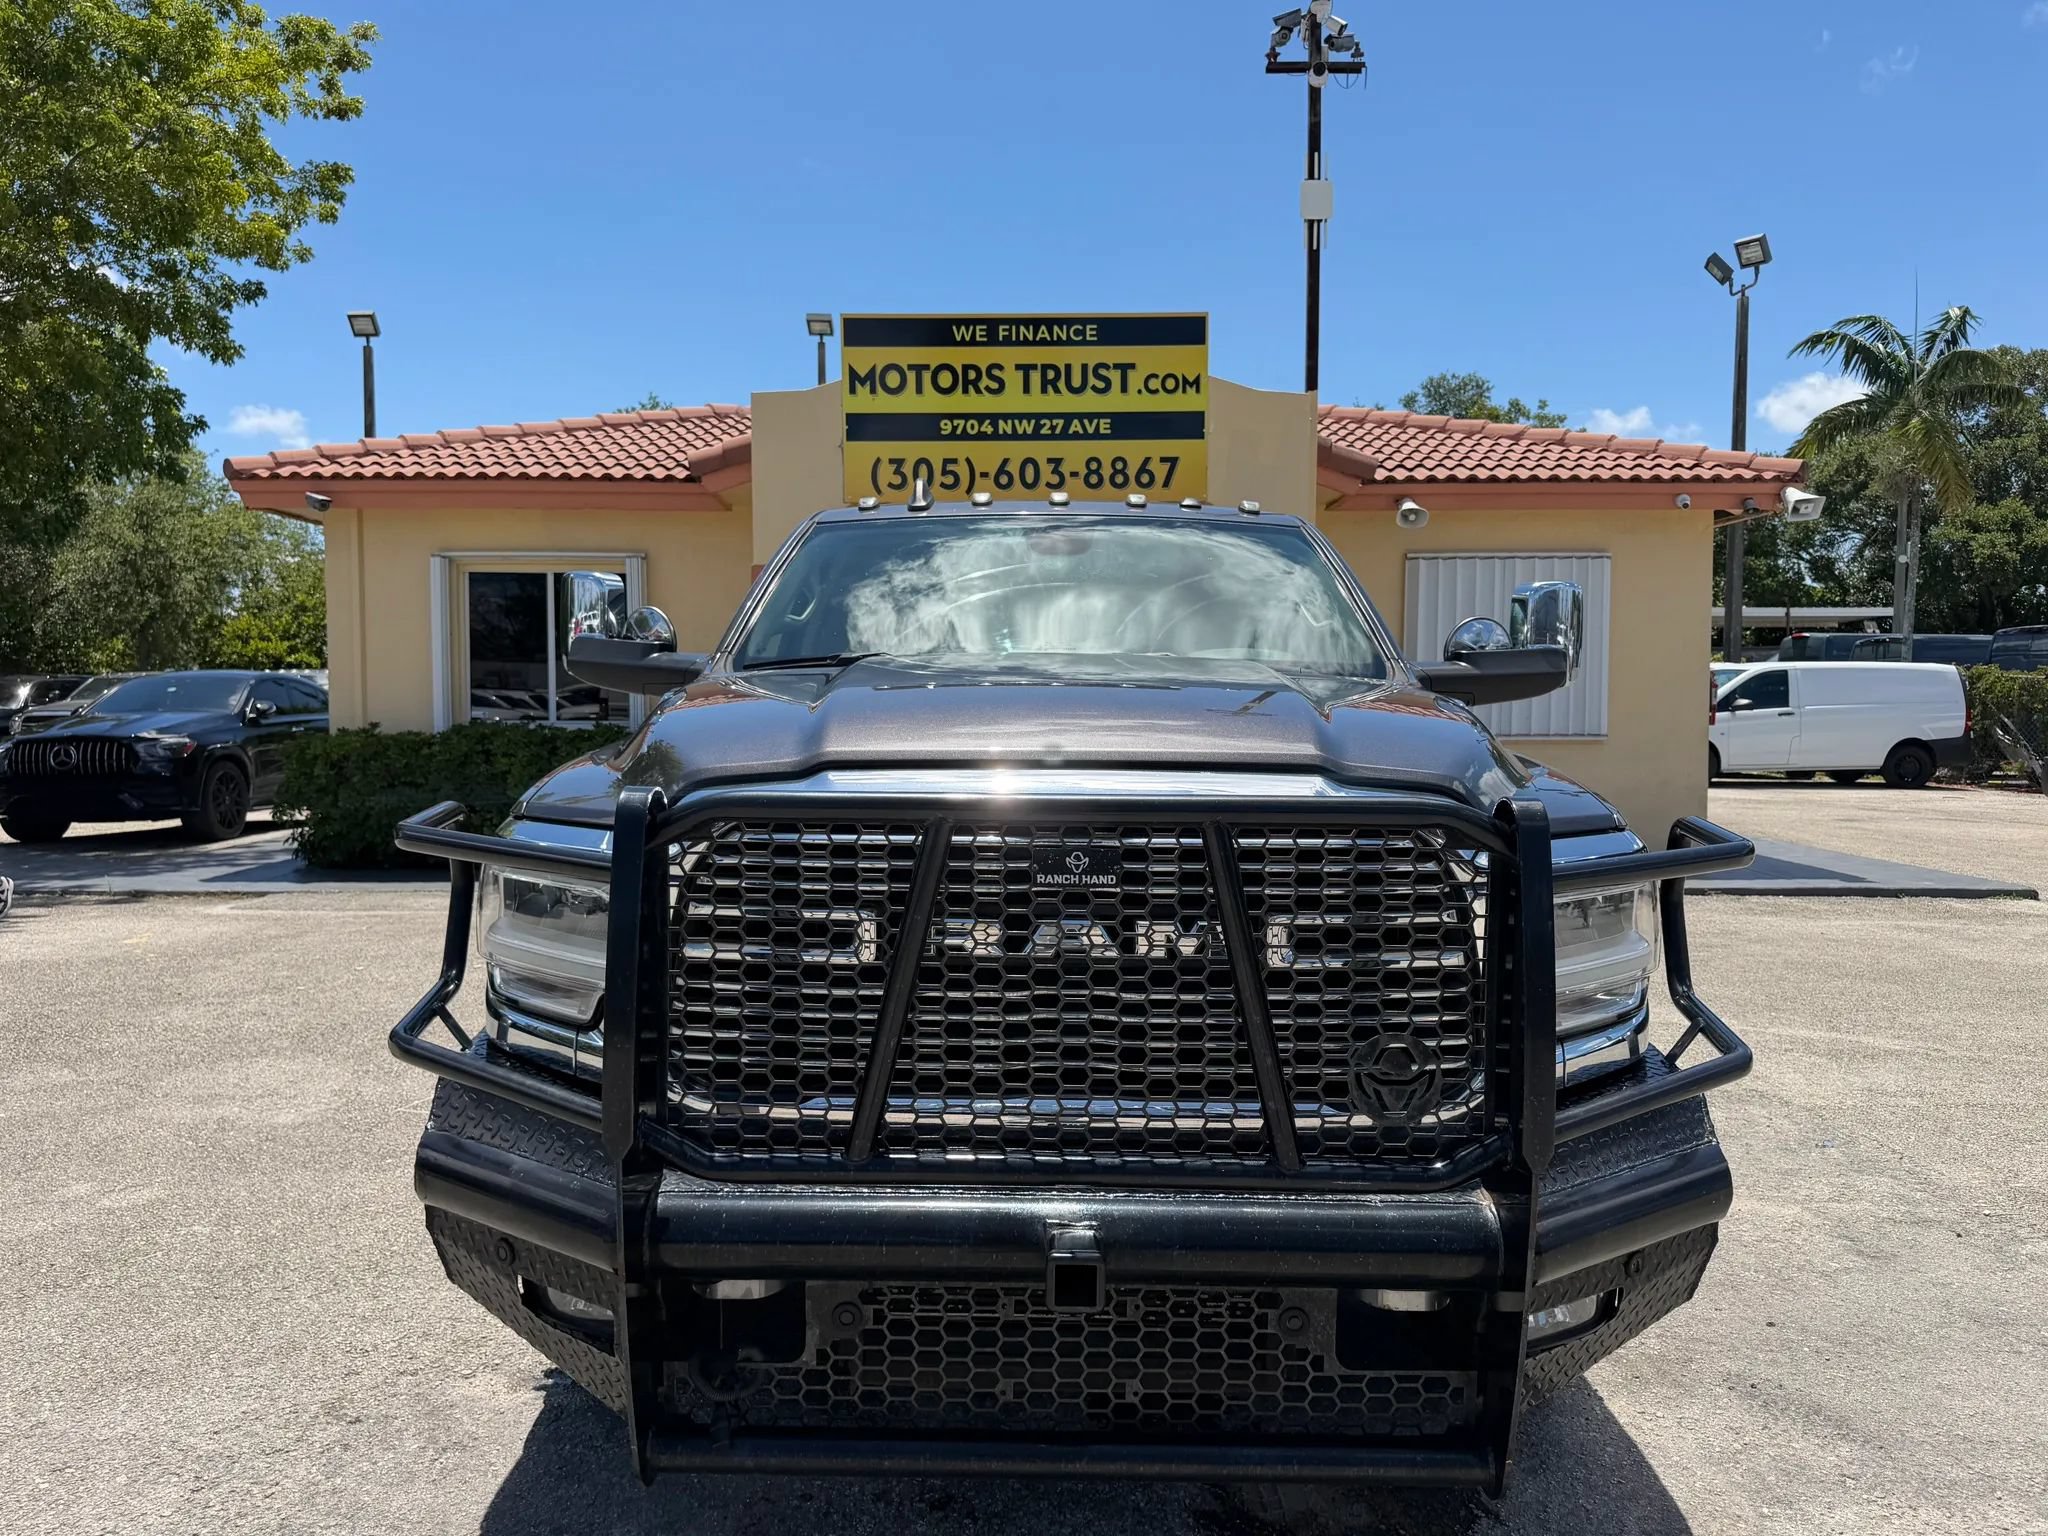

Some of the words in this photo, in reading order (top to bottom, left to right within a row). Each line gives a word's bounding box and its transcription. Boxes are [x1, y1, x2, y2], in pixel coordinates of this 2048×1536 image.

[952, 325, 988, 342] WE
[998, 324, 1098, 342] FINANCE
[848, 362, 1006, 397] MOTORS
[939, 419, 994, 435] 9704
[998, 419, 1035, 435] NW
[1039, 419, 1063, 435] 27
[1068, 418, 1112, 434] AVE
[871, 456, 1179, 496] (305)-603-8867
[1036, 874, 1079, 884] RANCH
[1082, 874, 1117, 885] HAND
[929, 917, 1230, 958] RAM
